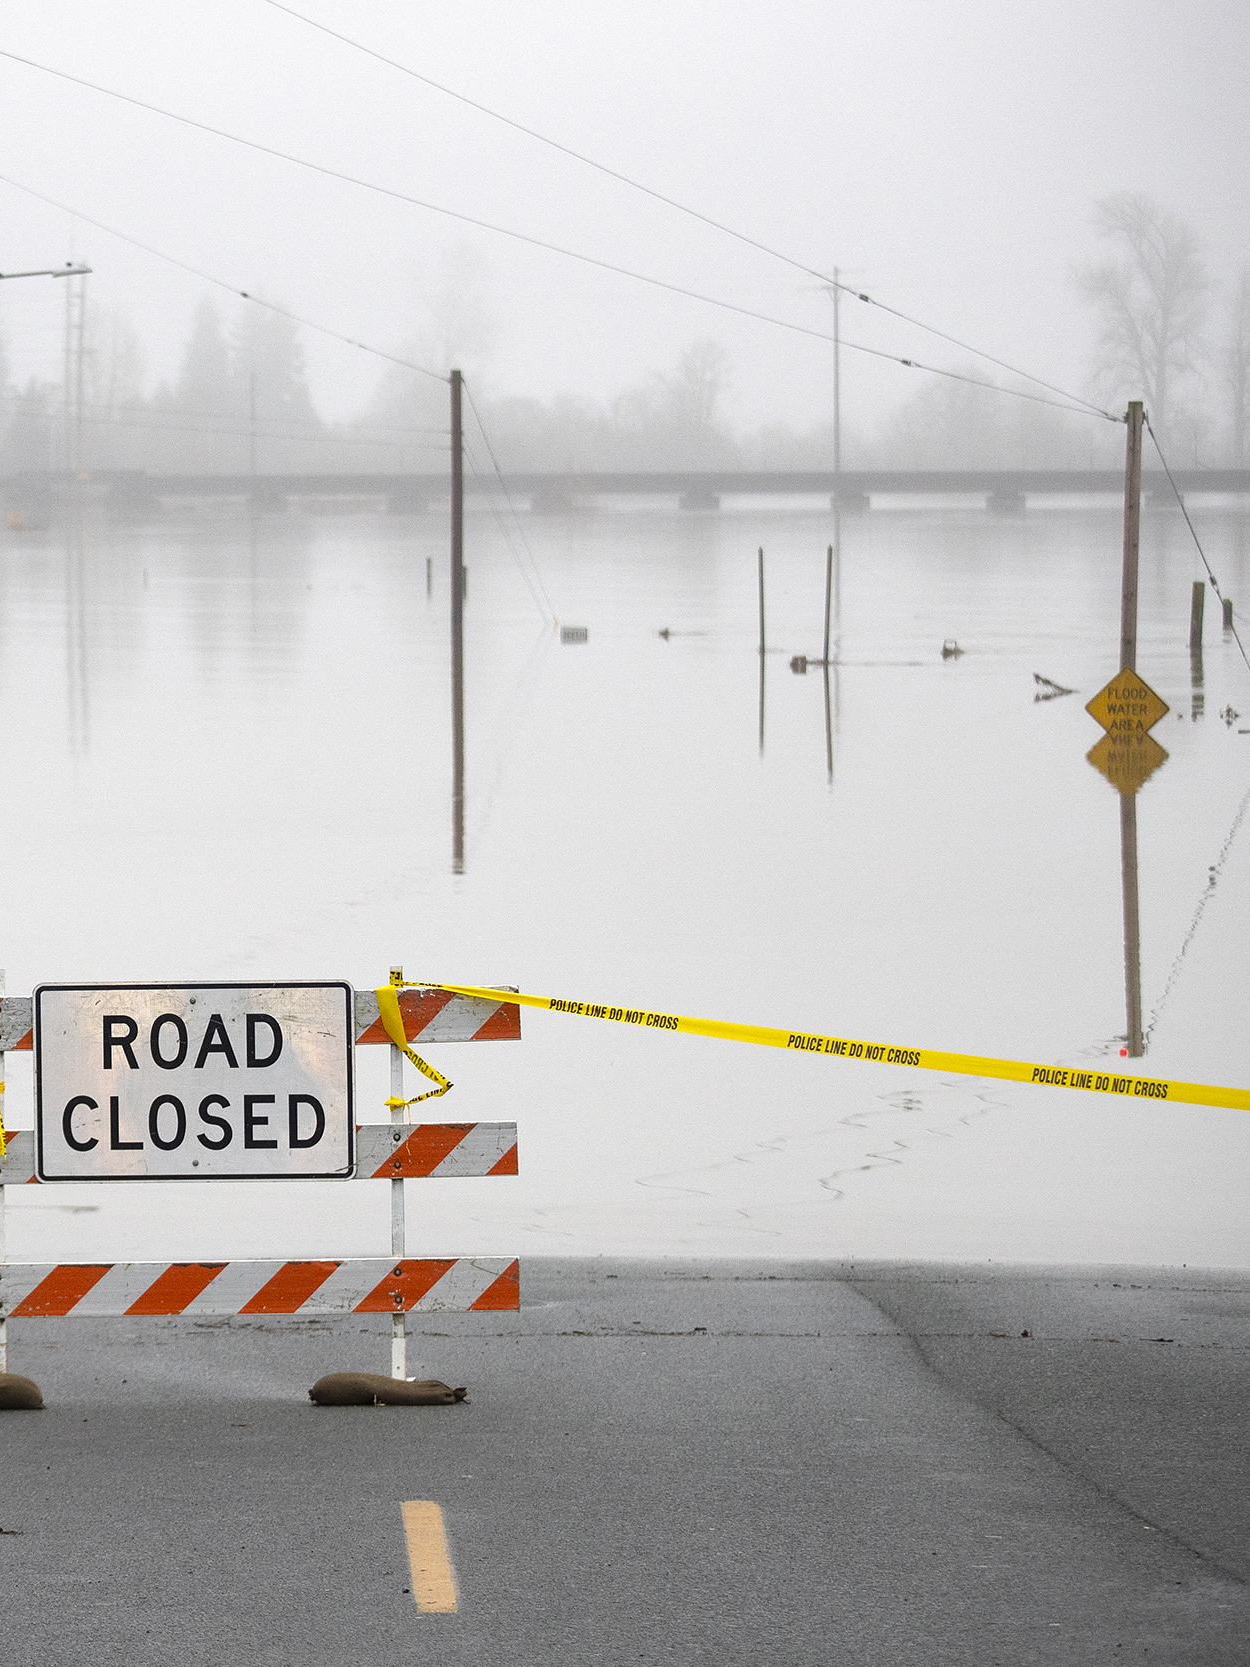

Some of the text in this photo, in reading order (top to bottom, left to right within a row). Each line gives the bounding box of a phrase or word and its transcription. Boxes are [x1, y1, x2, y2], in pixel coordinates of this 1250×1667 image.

[1107, 688, 1148, 700] FLOOD
[1107, 703, 1148, 716] WATER
[1110, 719, 1144, 731] AREA
[549, 998, 679, 1031] POLICE LINE DO NOT CROSS
[102, 1013, 283, 1070] ROAD
[787, 1034, 921, 1066] POLICE LINE DO NOT CROSS
[1031, 1067, 1169, 1099] POLICE LINE DO NOT CROSS
[62, 1094, 326, 1152] CLOSED
